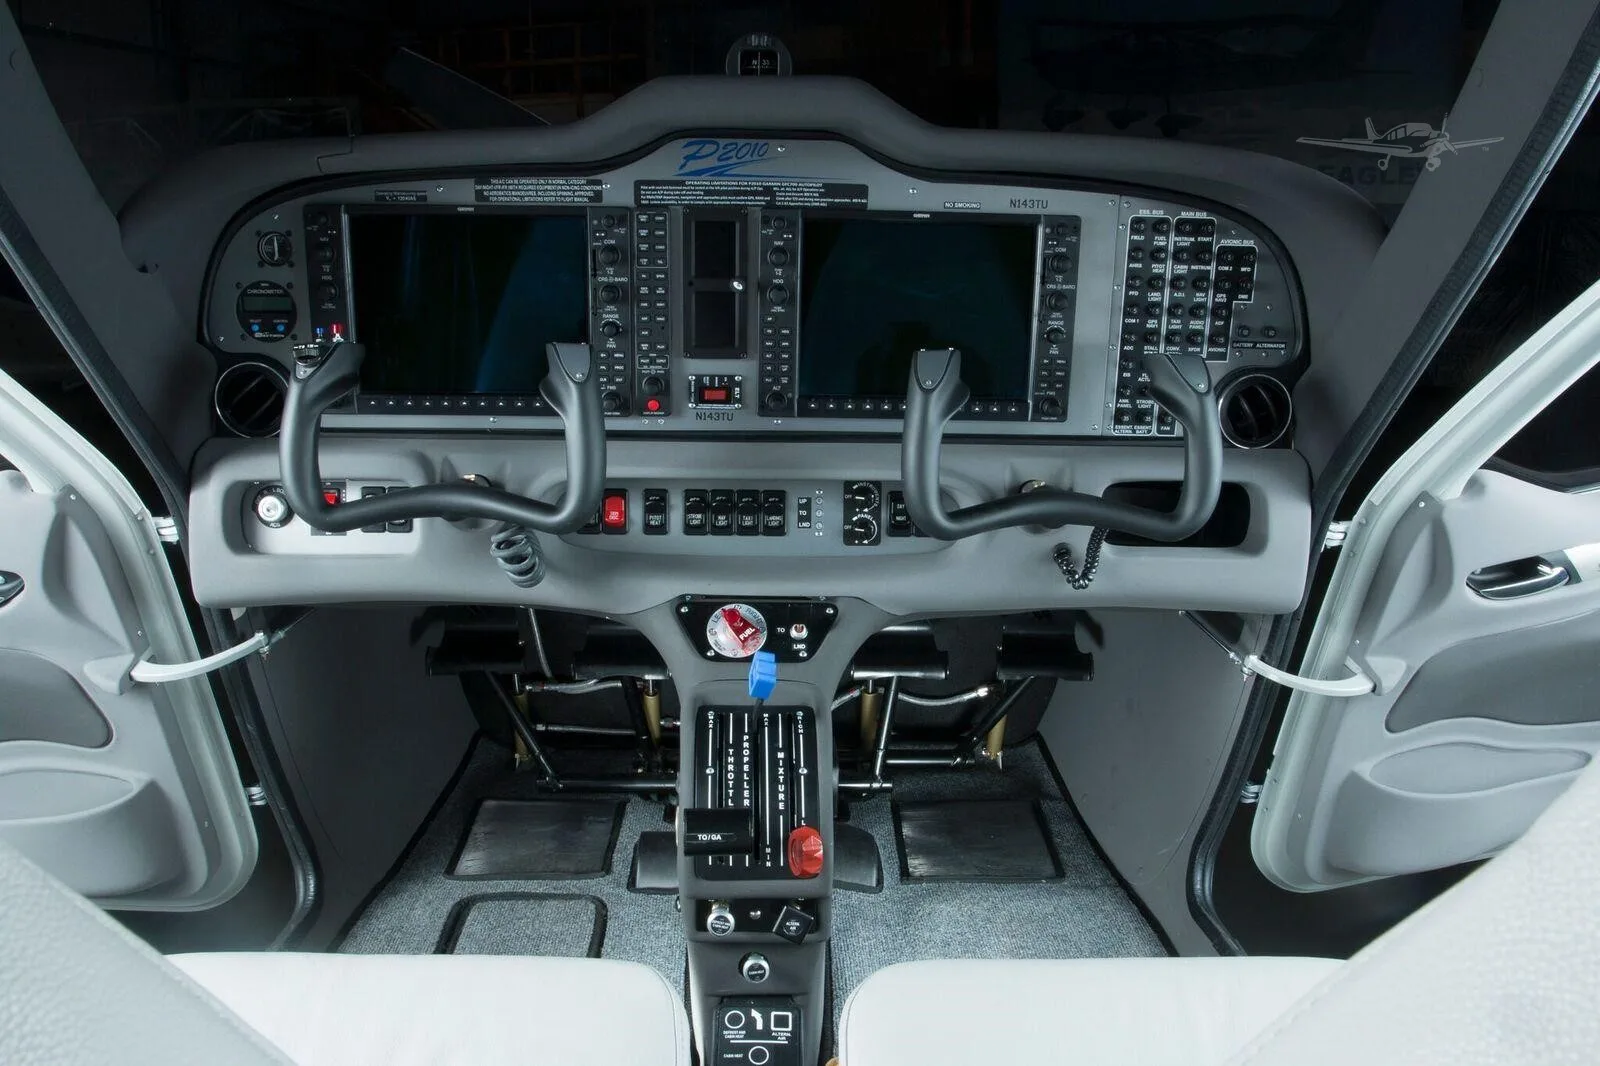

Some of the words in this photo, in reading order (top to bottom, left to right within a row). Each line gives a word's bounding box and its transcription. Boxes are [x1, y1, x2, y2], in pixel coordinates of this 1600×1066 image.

[679, 140, 770, 170] P2010
[1009, 198, 1048, 209] N143TU
[696, 412, 734, 421] N143TU
[738, 628, 756, 641] FUEL
